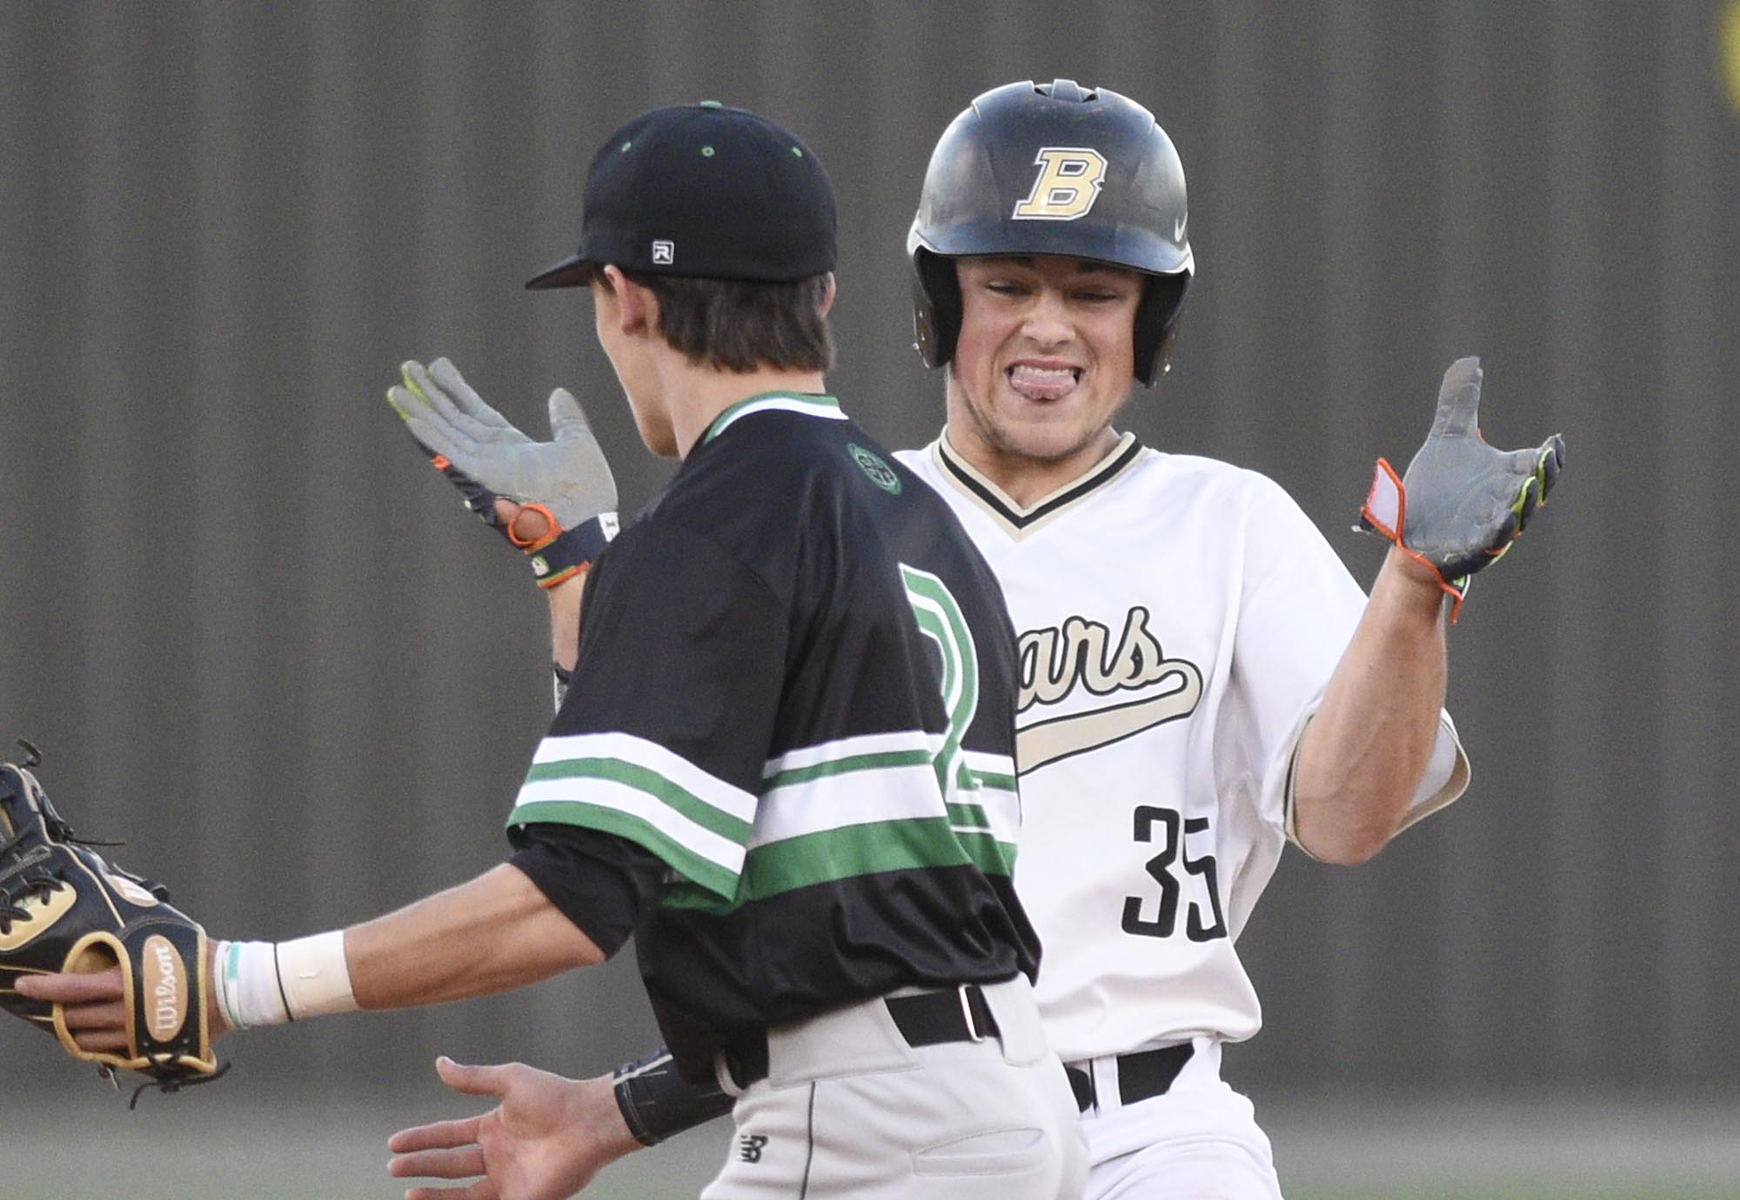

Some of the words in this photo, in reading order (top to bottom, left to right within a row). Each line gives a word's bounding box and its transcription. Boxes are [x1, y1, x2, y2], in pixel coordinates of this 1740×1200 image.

[1011, 147, 1108, 220] B
[1016, 606, 1175, 714] ars
[1121, 805, 1228, 942] 35
[154, 943, 178, 1033] Wilson
